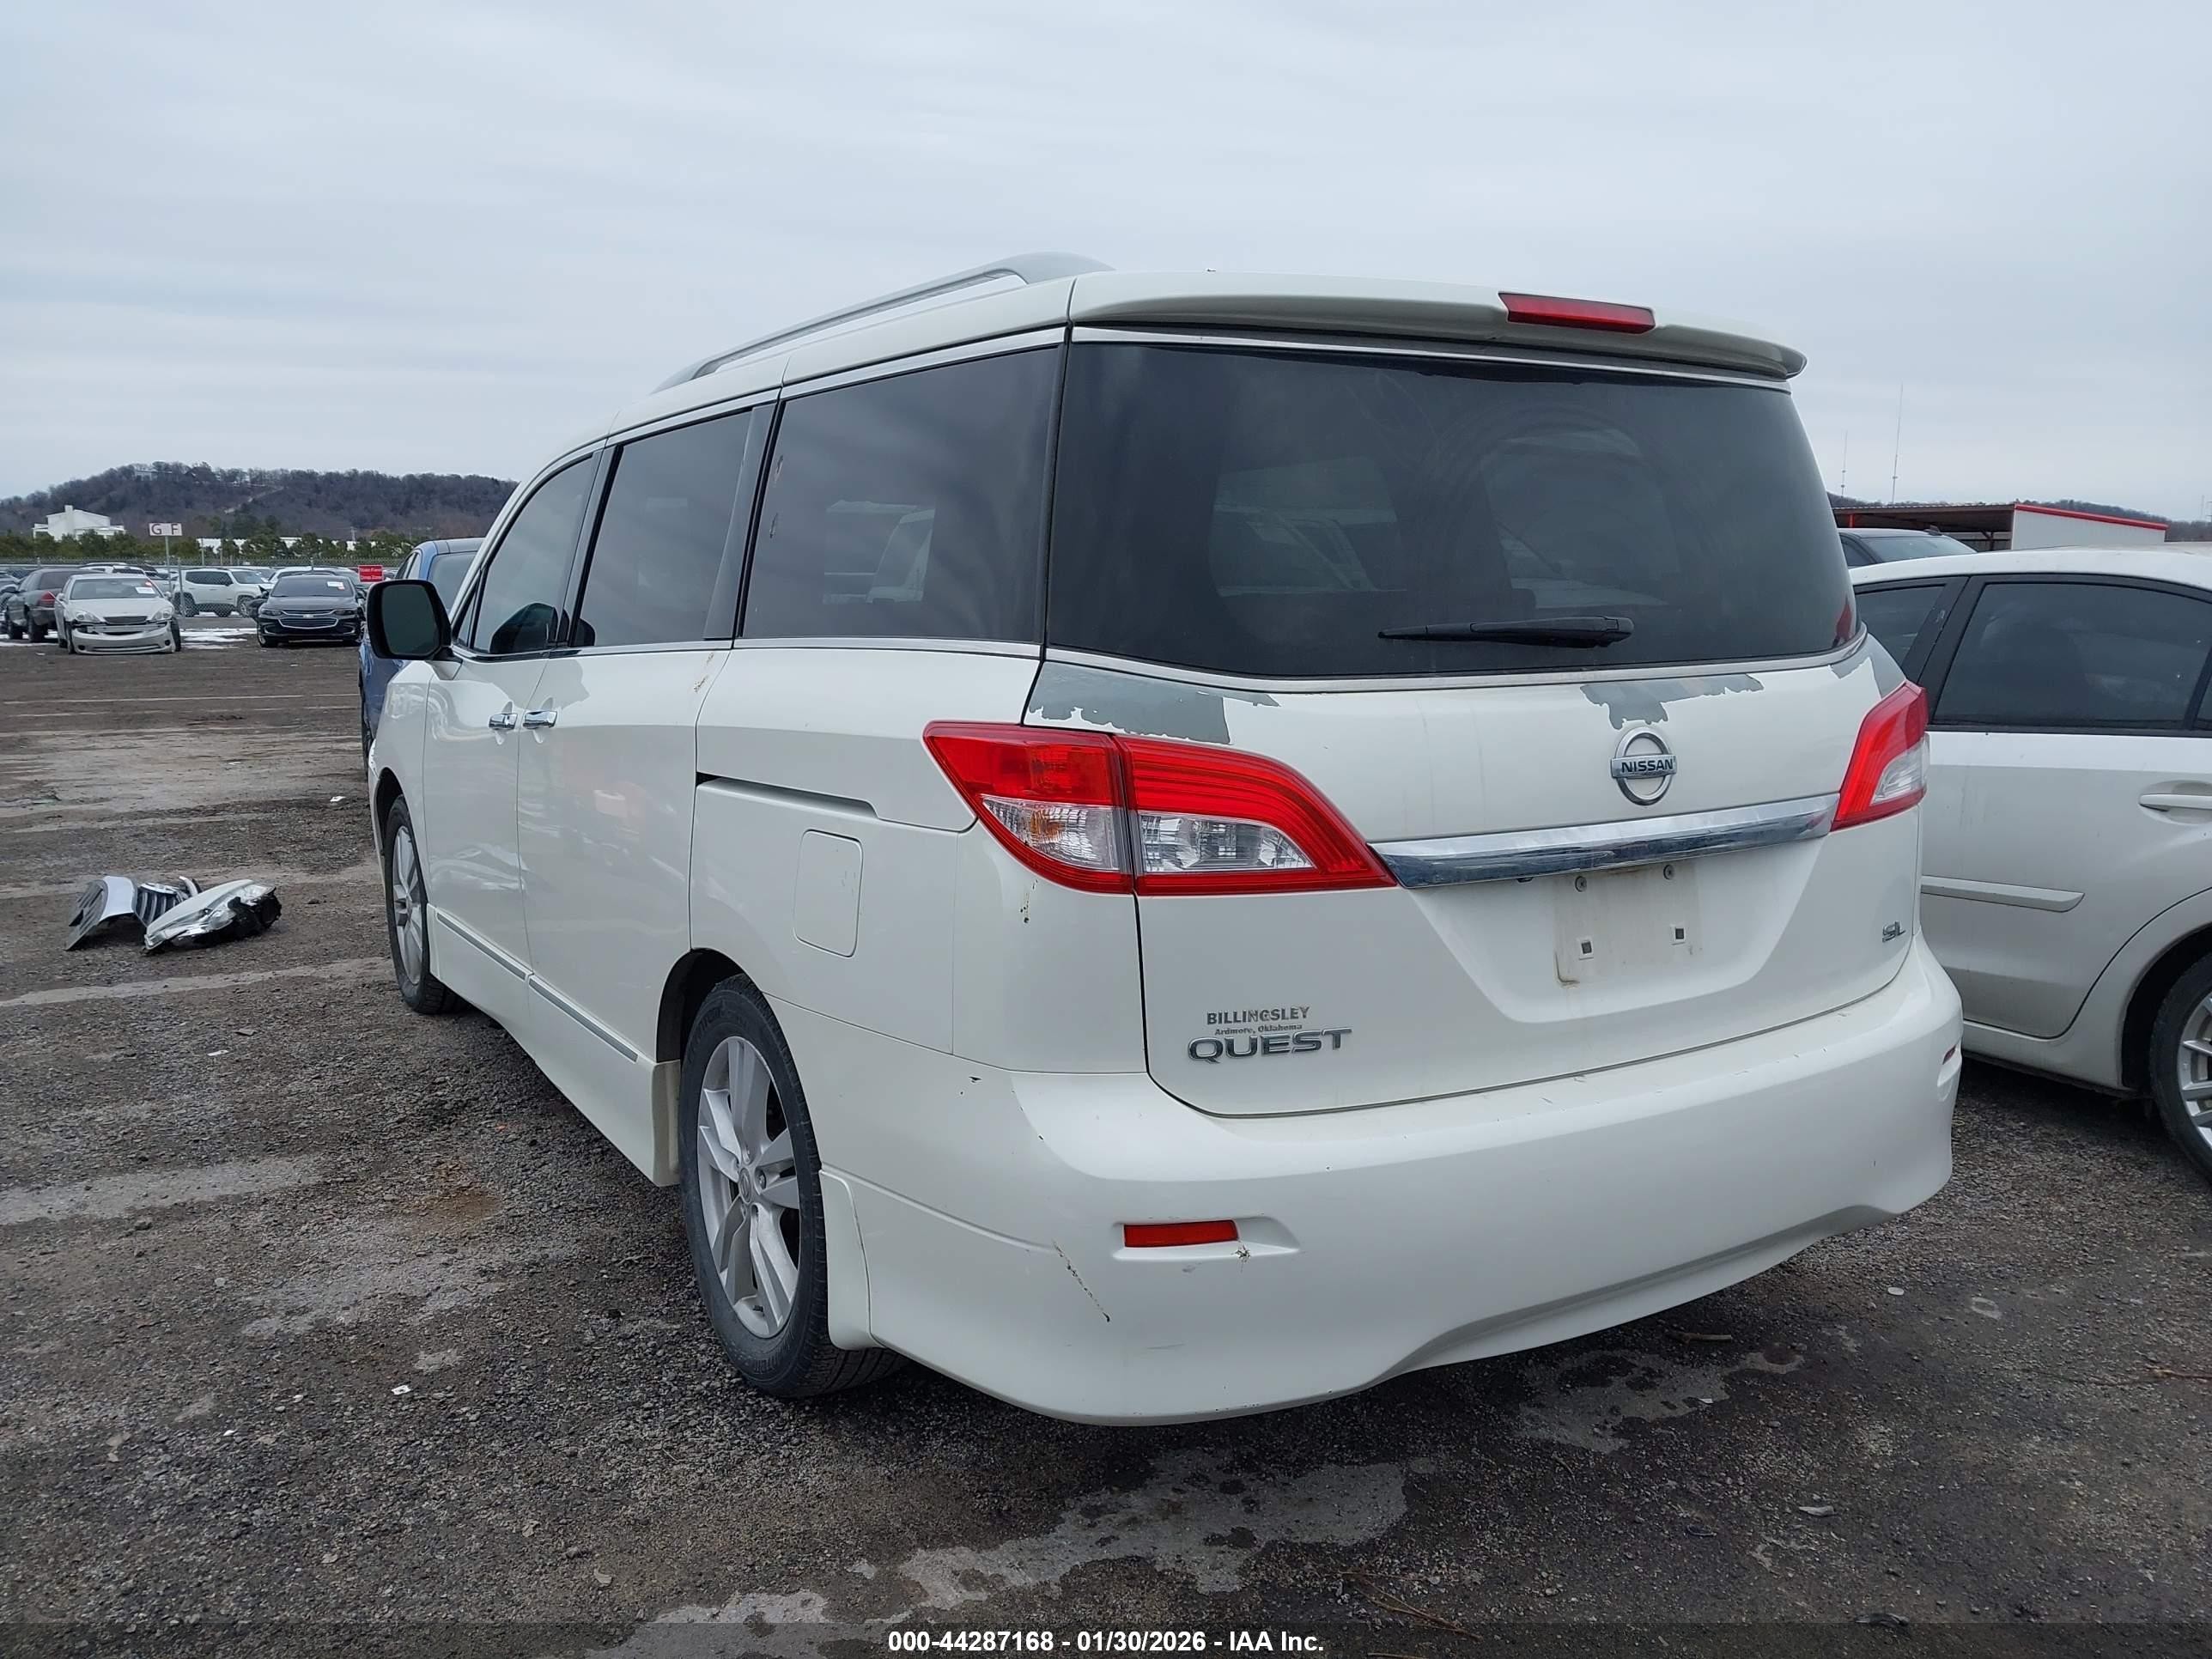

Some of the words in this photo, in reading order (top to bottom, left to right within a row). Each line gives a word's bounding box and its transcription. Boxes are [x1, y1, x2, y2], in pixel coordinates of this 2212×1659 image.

[151, 524, 162, 535] G
[171, 523, 179, 535] F
[1621, 758, 1674, 773] NISSAN
[1881, 921, 1906, 943] SL
[1206, 1006, 1310, 1025] BILLINGSLEY
[1188, 1027, 1353, 1064] QUEST
